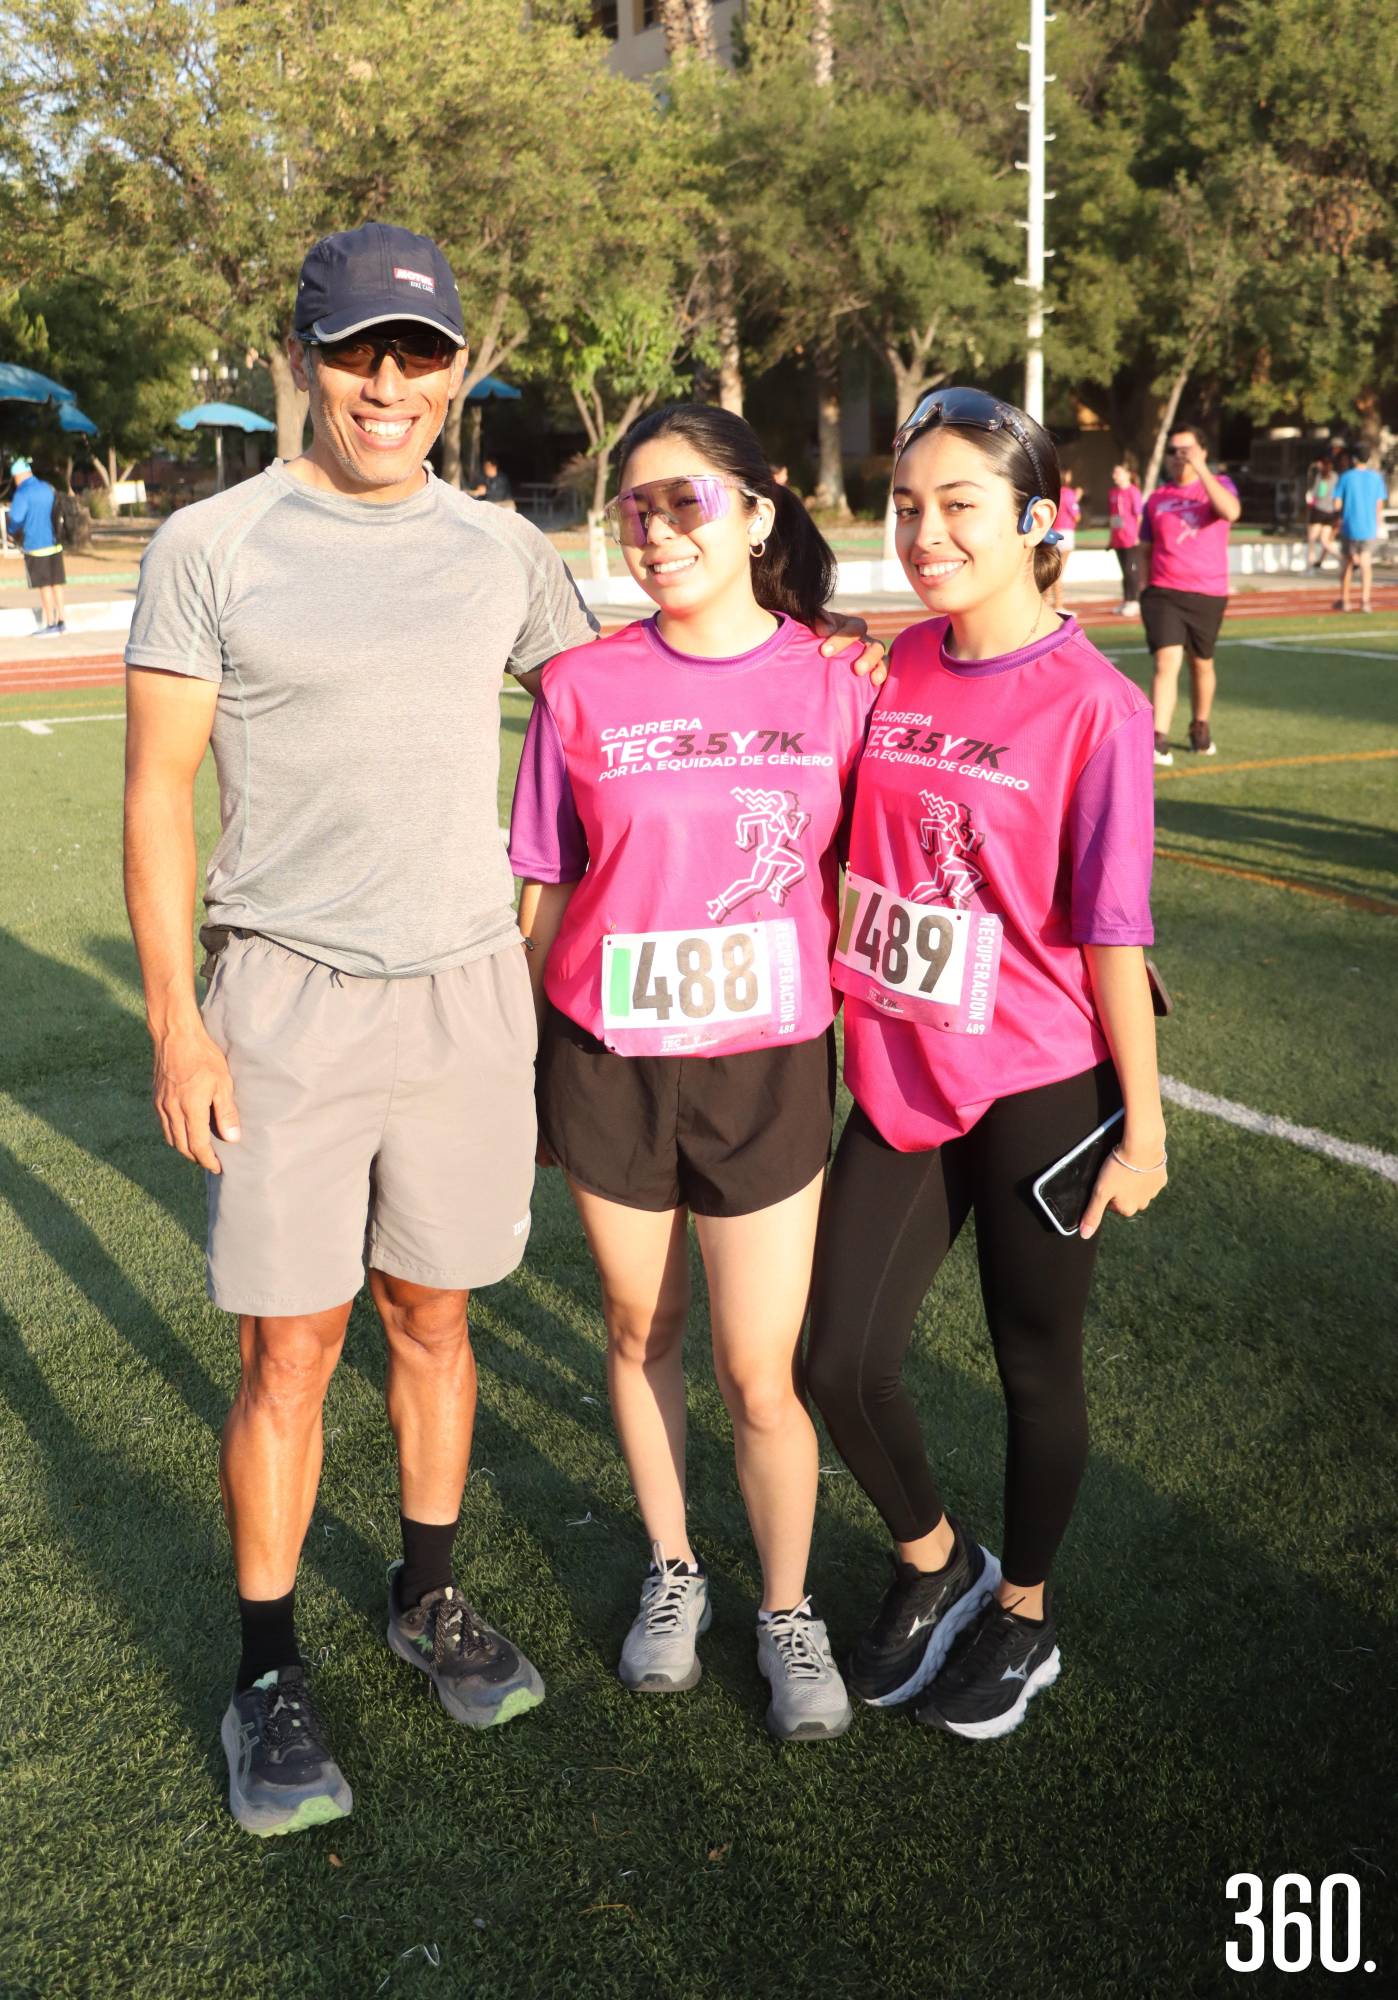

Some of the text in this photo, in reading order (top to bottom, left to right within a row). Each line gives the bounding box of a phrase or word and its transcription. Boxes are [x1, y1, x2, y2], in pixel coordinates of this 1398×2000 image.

[600, 718, 703, 741] CARRERA
[871, 710, 933, 727] CARRERA
[598, 751, 834, 782] POR LA EQUIDAD DE GÉNERO
[880, 750, 937, 768] EQUIDAD
[936, 759, 958, 772] DE
[958, 764, 1030, 791] GÉNERO
[854, 892, 954, 994] 489
[632, 933, 759, 1020] 488
[775, 922, 796, 1023] RECUPERACION
[967, 917, 997, 1021] RECUPERACION
[966, 1023, 986, 1035] 489
